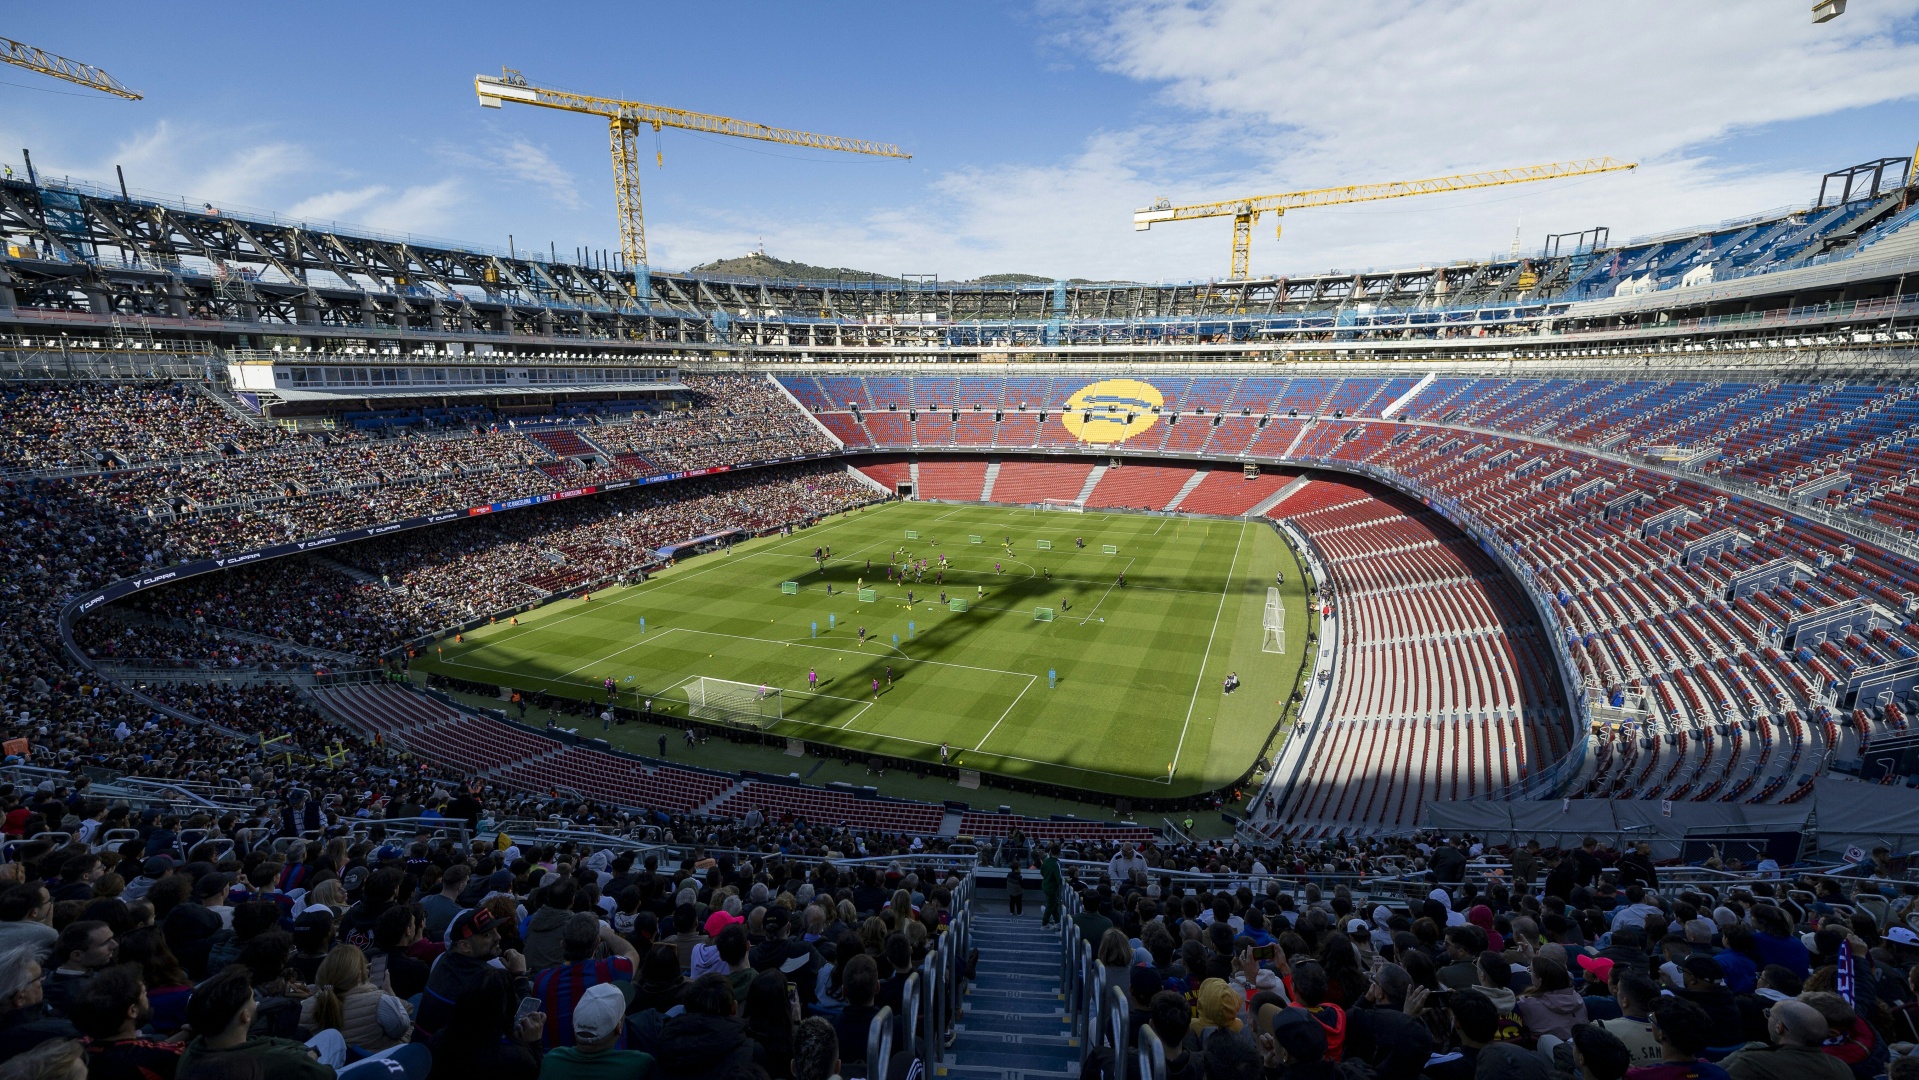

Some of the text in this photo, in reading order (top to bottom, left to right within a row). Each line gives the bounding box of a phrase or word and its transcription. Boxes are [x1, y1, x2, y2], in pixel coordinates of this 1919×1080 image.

[435, 513, 458, 521] CUPRA
[375, 524, 401, 533] CUPRA
[307, 537, 336, 547] CUPRA
[227, 552, 261, 564] CUPRA
[143, 572, 177, 585] CUPRA
[84, 595, 105, 609] CUPRA
